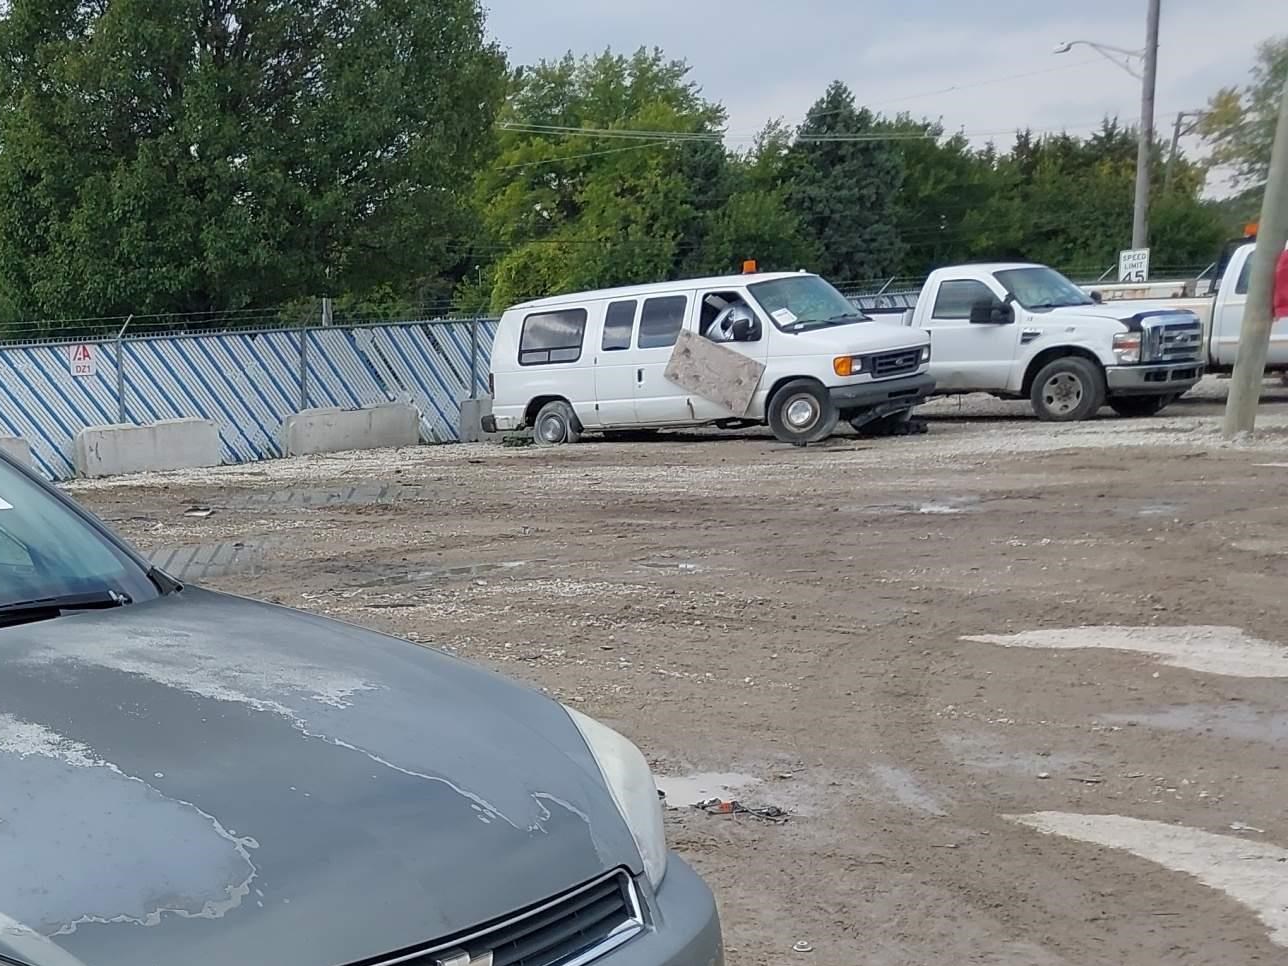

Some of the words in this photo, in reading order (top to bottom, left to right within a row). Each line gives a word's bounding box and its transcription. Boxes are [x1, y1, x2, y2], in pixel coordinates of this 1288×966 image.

[1123, 253, 1146, 261] SPEED
[1124, 261, 1143, 270] LIMIT
[1122, 269, 1145, 283] 45
[75, 364, 91, 374] DZ1
